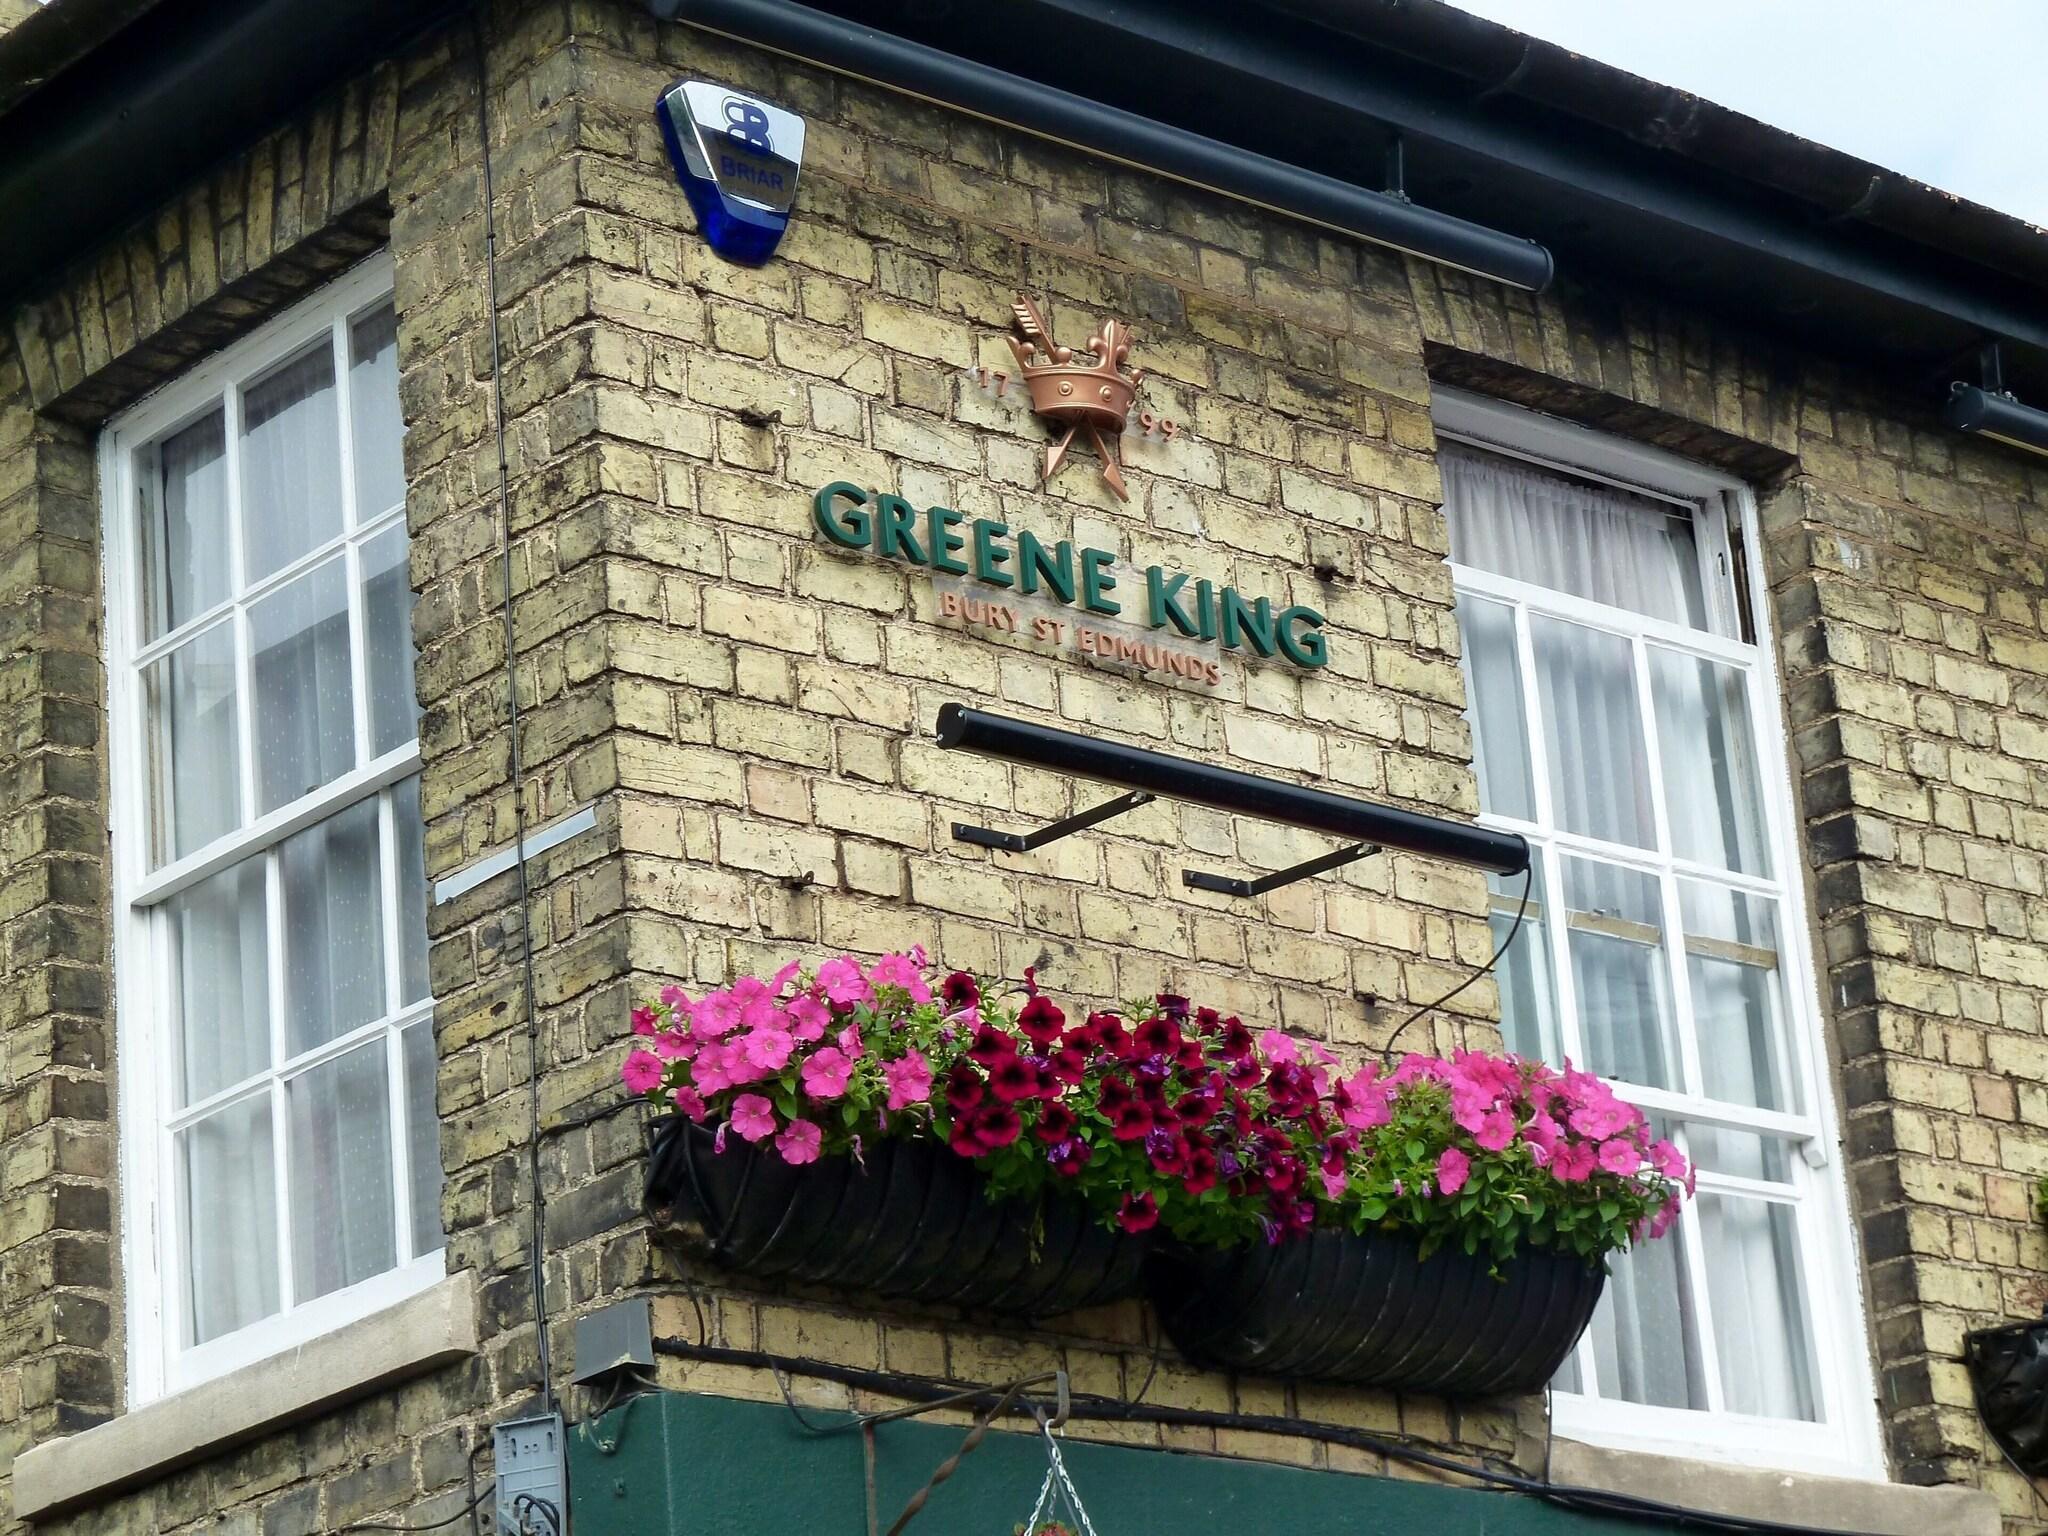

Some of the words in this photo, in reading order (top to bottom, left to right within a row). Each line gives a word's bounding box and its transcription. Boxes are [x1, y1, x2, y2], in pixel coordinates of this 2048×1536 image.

[720, 155, 784, 191] BRIAR
[976, 367, 1009, 397] 17
[1137, 410, 1178, 442] 99
[815, 481, 1121, 616] GREENE
[1146, 565, 1328, 669] KING
[939, 591, 1019, 632] BURY
[1033, 615, 1066, 645] ST
[1077, 627, 1221, 686] EDMUNDS
